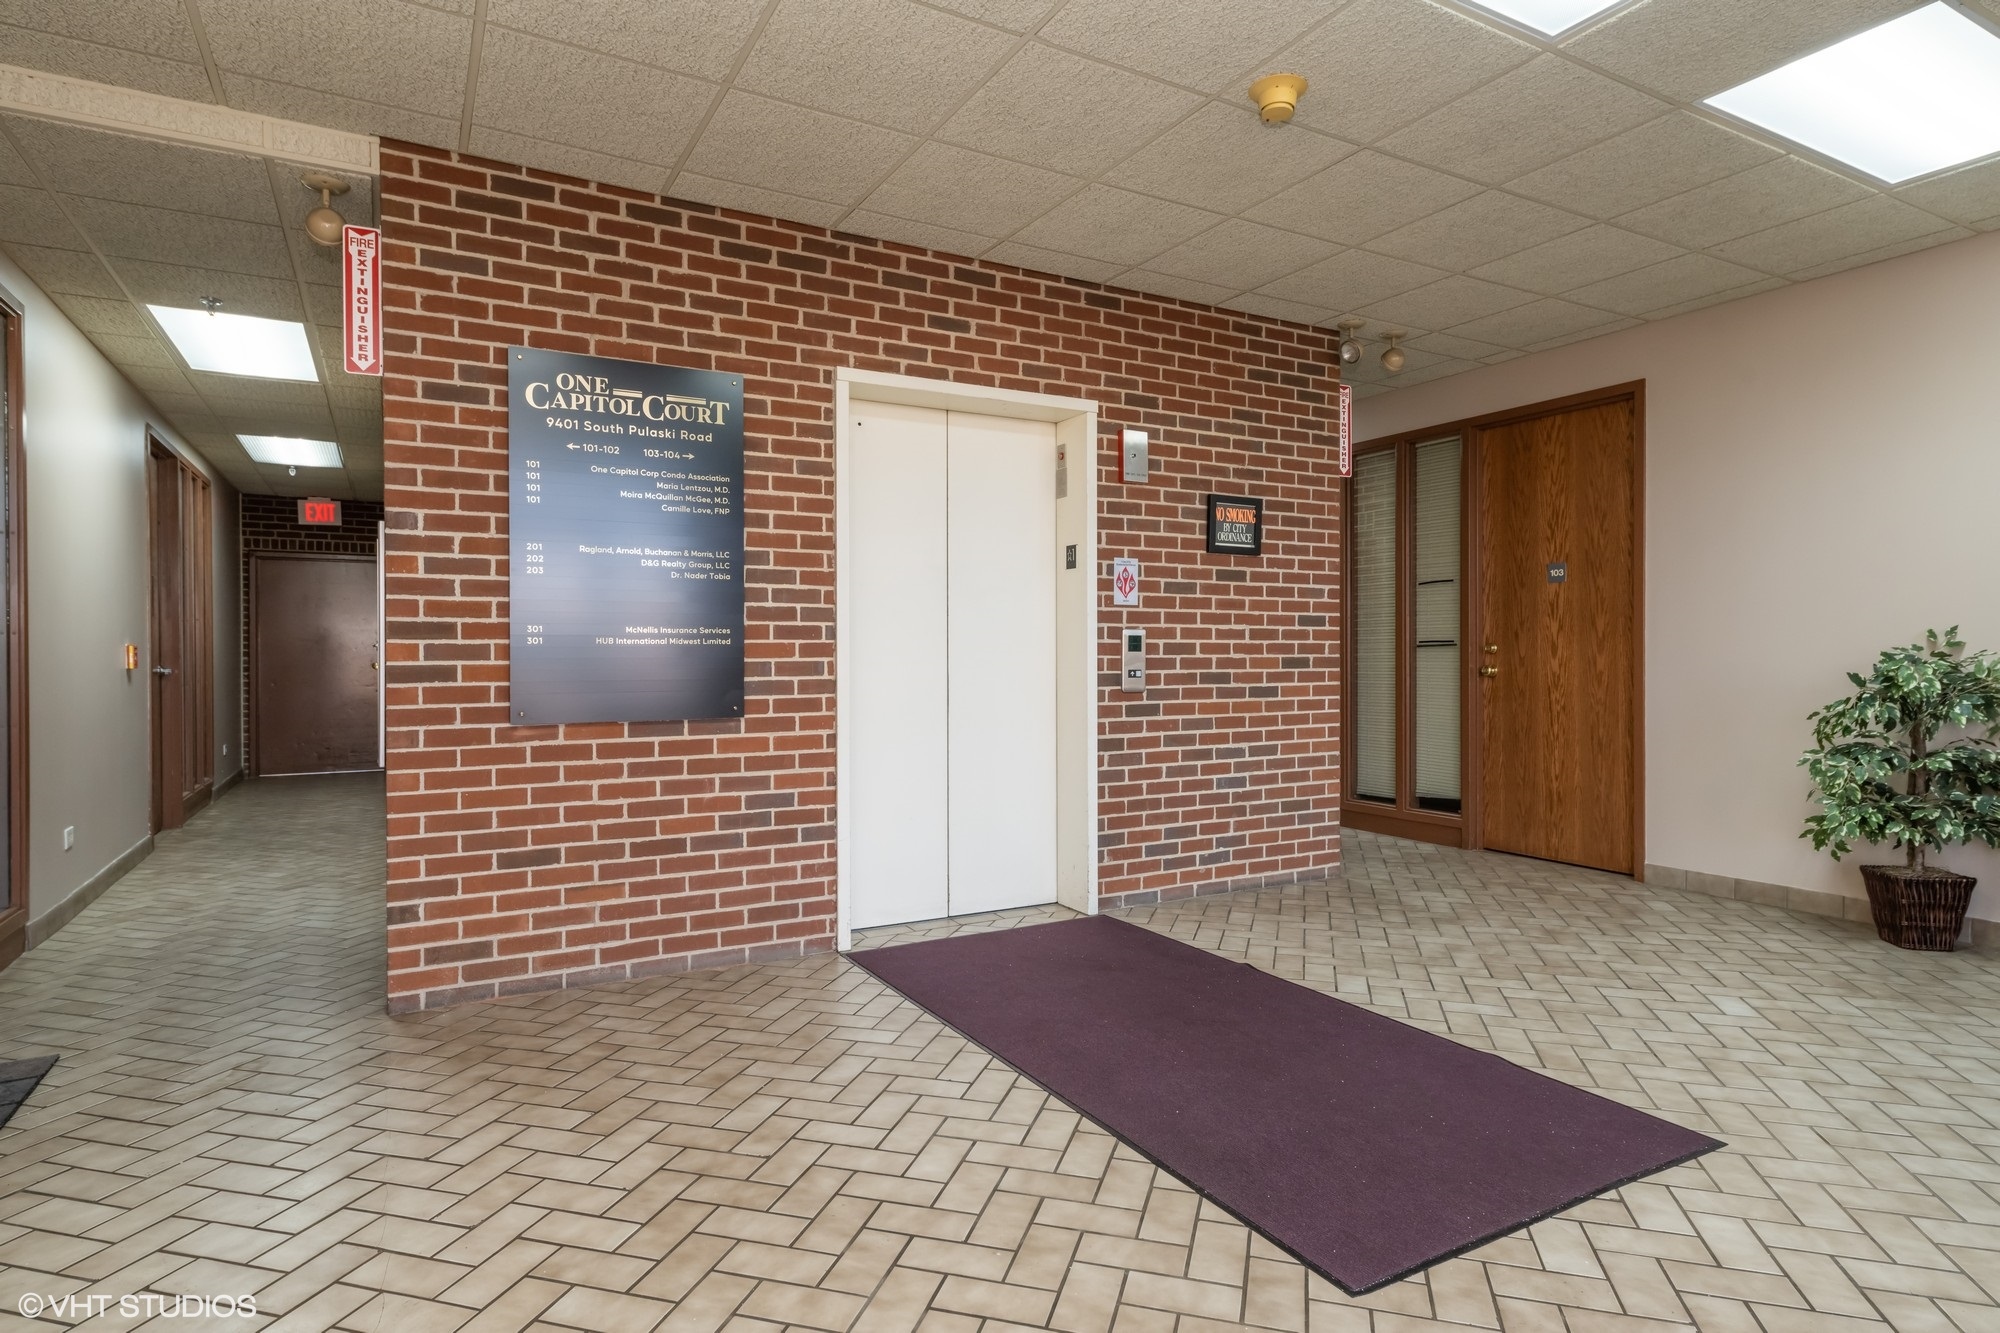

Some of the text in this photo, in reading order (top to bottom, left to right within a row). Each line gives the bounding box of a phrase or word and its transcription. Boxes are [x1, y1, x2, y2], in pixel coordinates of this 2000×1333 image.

[350, 236, 374, 249] FIRE
[357, 250, 368, 361] EXTINGUISHER
[556, 373, 609, 394] ONE
[546, 417, 712, 442] 9401 South Pulaski Road
[583, 444, 619, 454] 101-102
[643, 449, 680, 459] 103-104
[591, 466, 730, 483] One Capitol Corp Condo Association
[657, 482, 678, 490] Maria
[681, 484, 713, 494] Lentzou,
[620, 491, 642, 499] Moira
[645, 492, 683, 501] McQuillan
[686, 494, 713, 504] McGee,
[305, 502, 336, 523] EXIT
[662, 505, 690, 513] Camille
[693, 507, 713, 515] Love,
[1216, 507, 1256, 524] NO SMOKING
[1223, 522, 1247, 533] BY CITY
[1218, 532, 1252, 542] ORDINANCE
[579, 545, 614, 555] Ragland,
[616, 547, 643, 556] Arnold,
[644, 548, 682, 556] Buchanan
[691, 550, 715, 559] Morris,
[662, 560, 686, 569] Realty
[689, 561, 713, 570] Group,
[1550, 568, 1564, 577] 103
